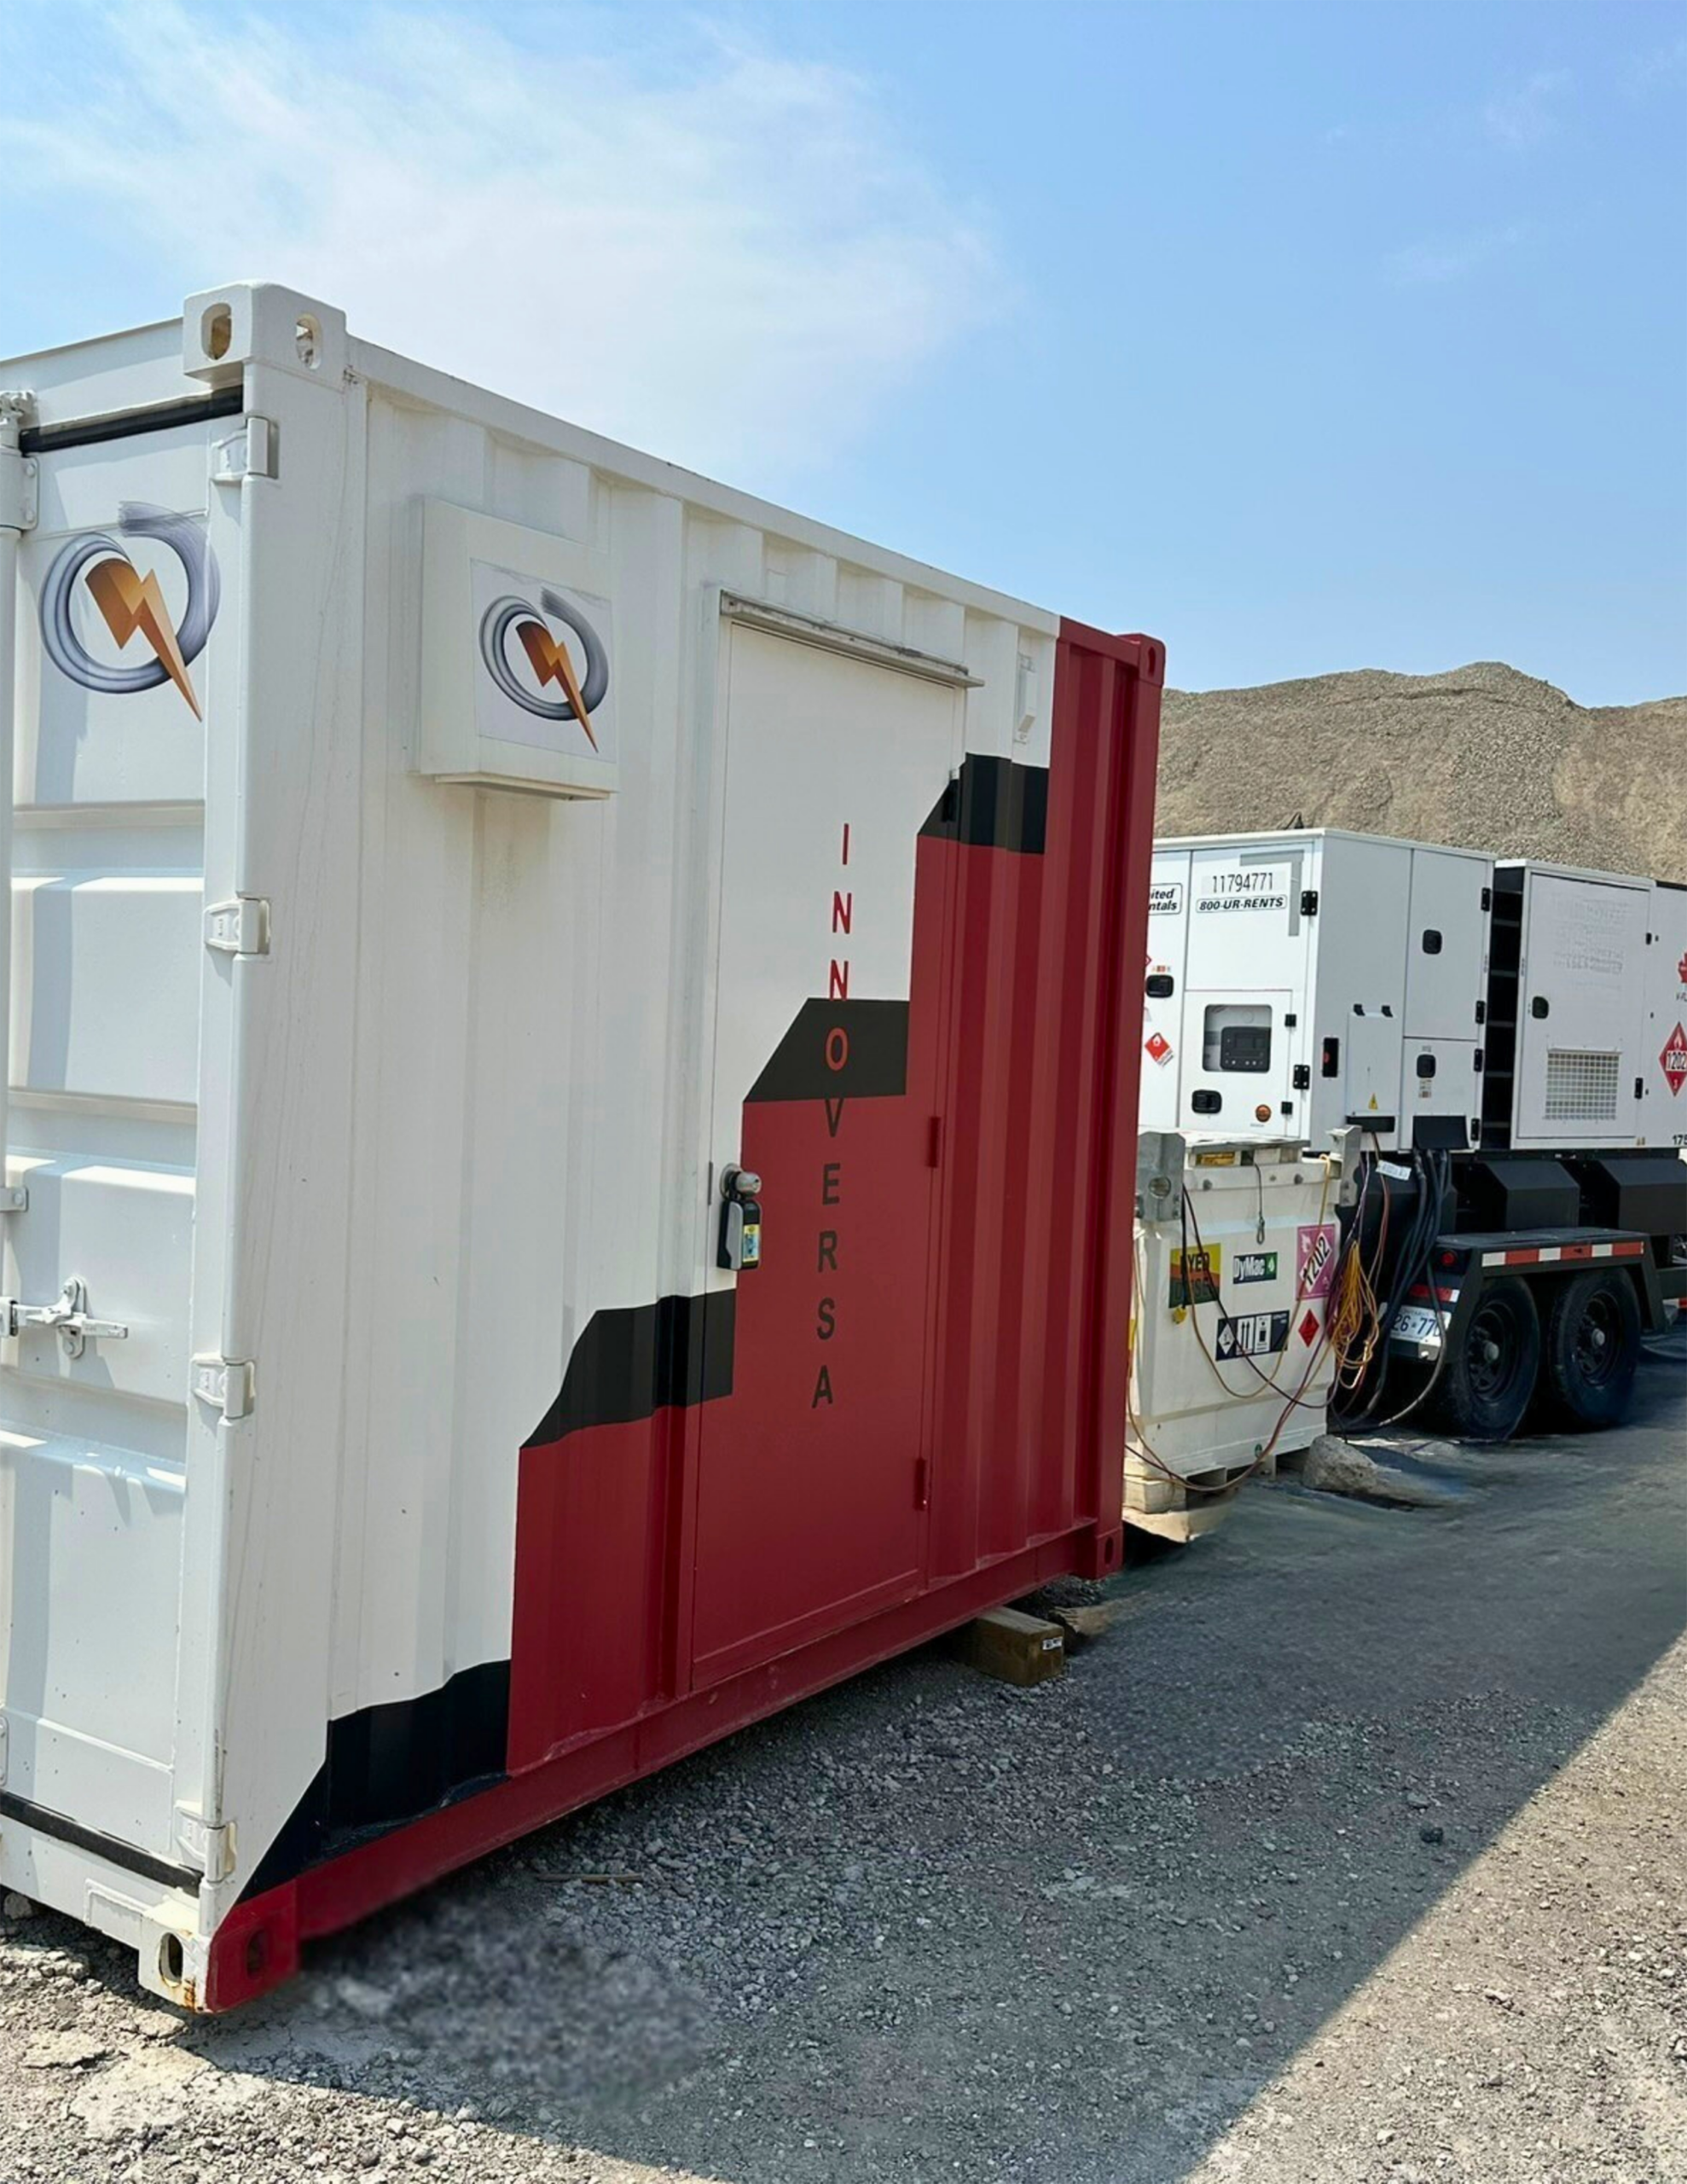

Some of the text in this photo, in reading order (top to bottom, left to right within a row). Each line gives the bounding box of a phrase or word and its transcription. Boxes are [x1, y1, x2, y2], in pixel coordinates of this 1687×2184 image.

[1213, 873, 1272, 893] 11794771
[1151, 888, 1175, 899] ited
[1148, 900, 1177, 910] ntals
[1199, 897, 1284, 911] 800-UR-RENTS
[812, 823, 851, 1409] INNOVERSA
[1233, 1257, 1265, 1281] DyMac
[1303, 1236, 1330, 1286] 1202
